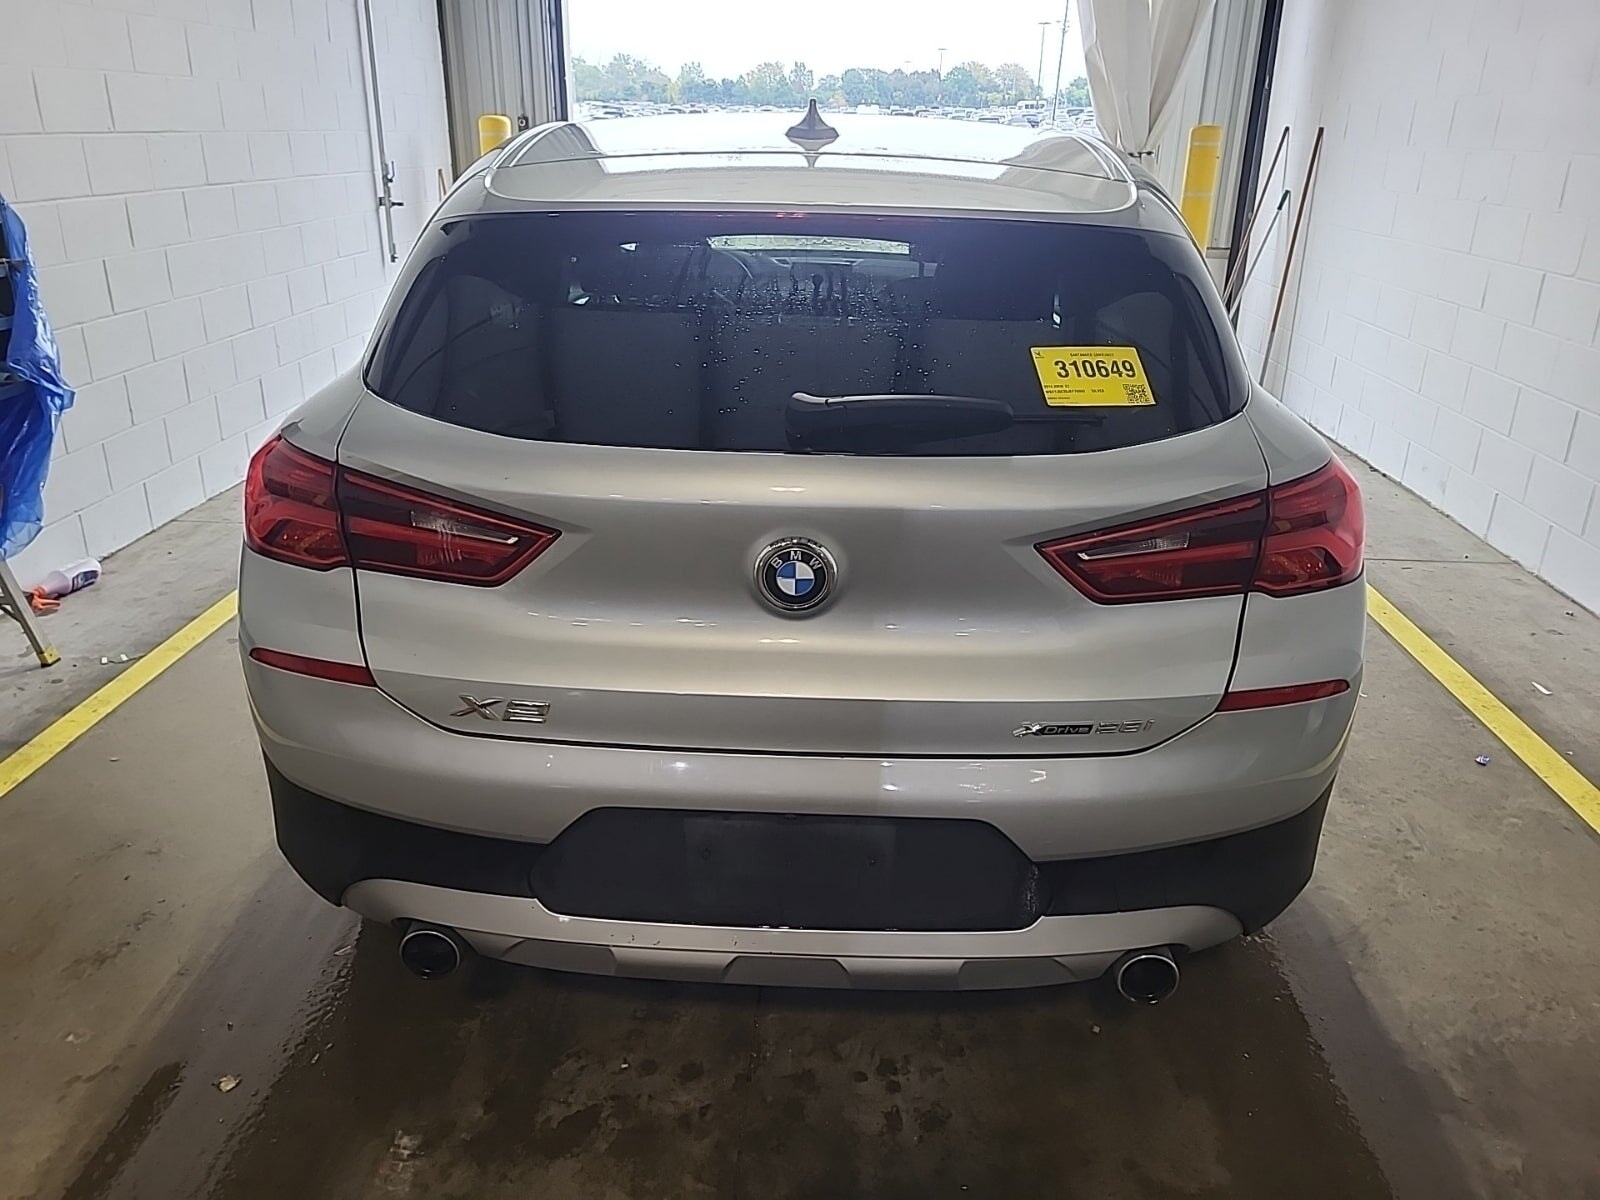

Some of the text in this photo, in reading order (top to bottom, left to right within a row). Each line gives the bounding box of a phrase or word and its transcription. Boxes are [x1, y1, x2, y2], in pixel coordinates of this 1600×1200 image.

[1054, 360, 1136, 378] 310649
[770, 551, 822, 570] BMW
[449, 694, 550, 724] X2
